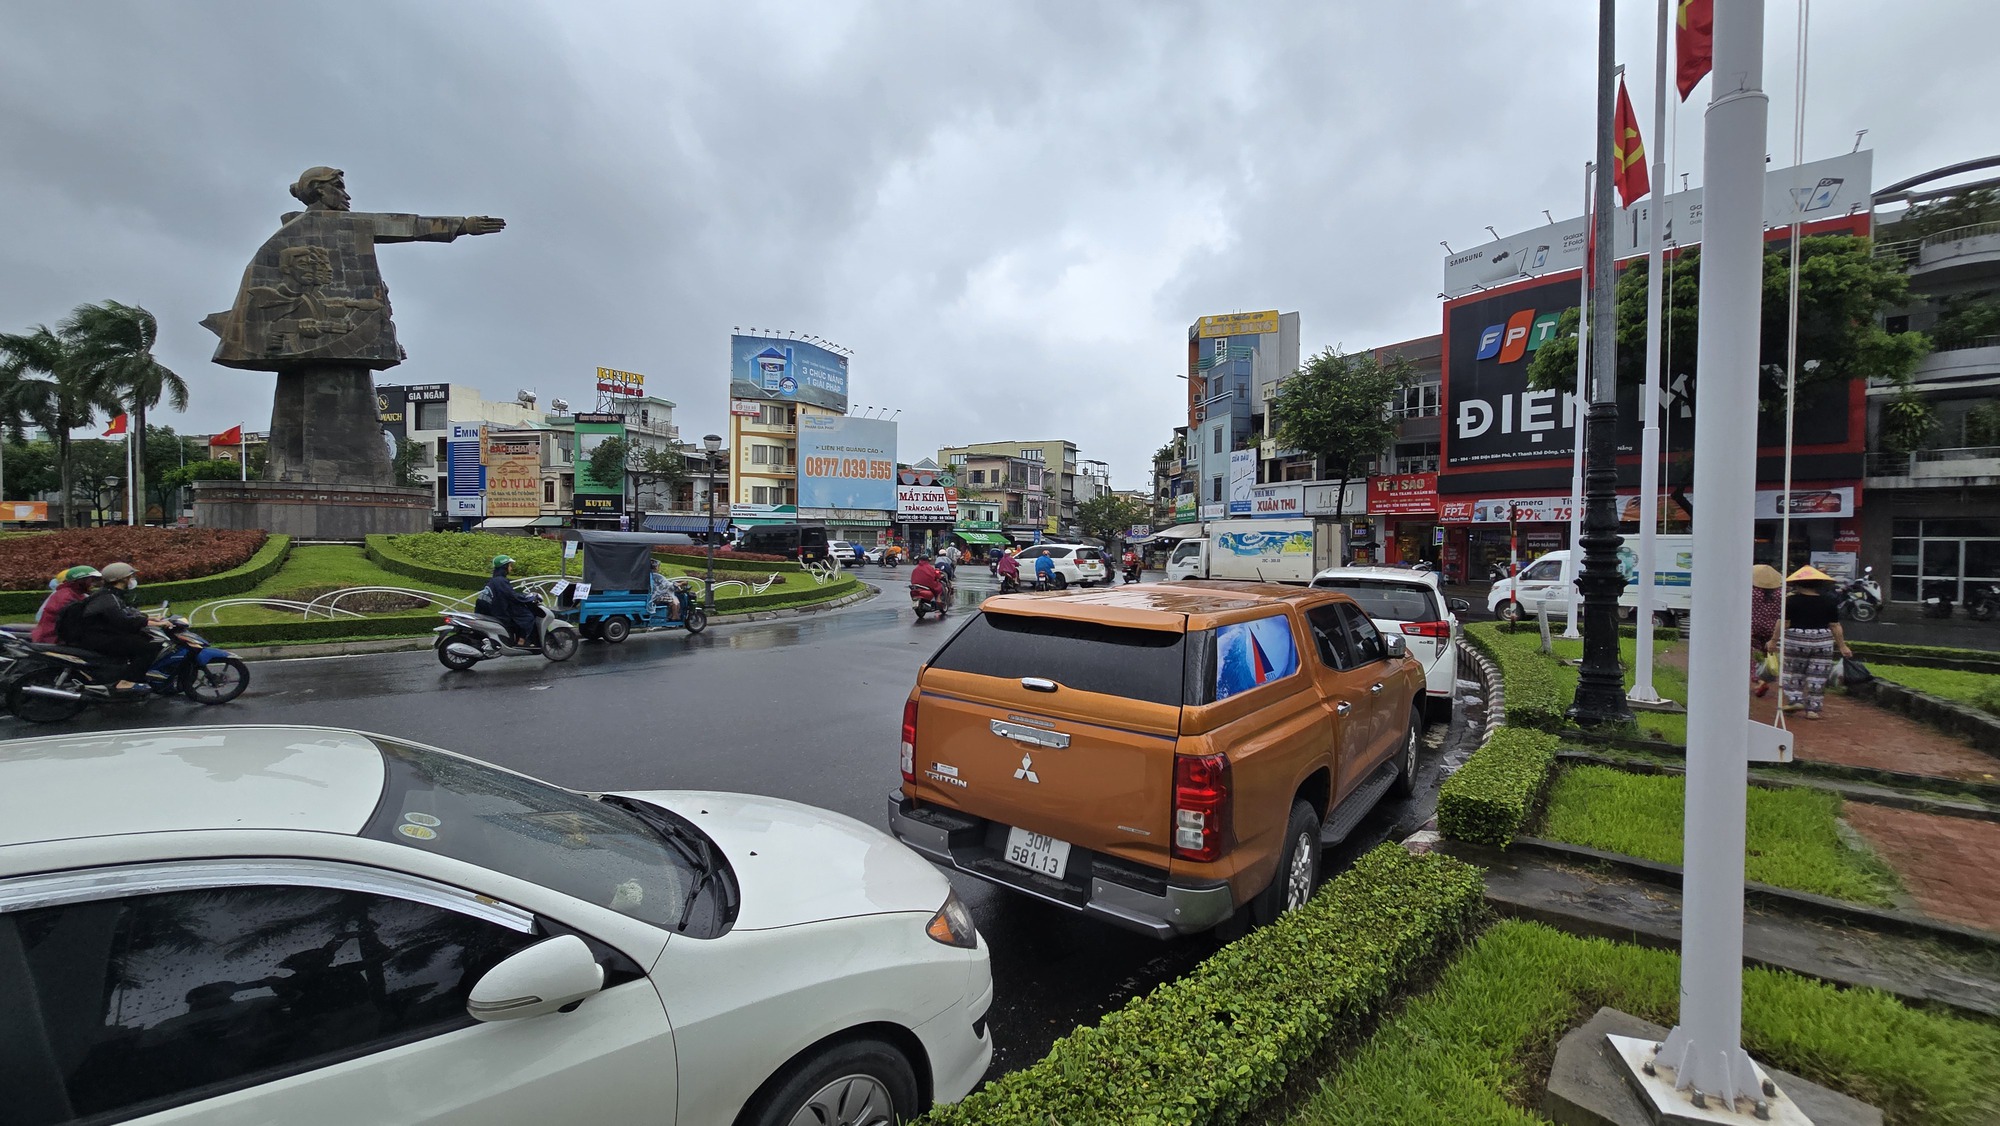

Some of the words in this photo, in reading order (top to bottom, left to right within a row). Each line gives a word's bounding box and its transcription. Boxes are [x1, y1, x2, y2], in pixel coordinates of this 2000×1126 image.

[1563, 231, 1585, 241] Galax
[1568, 238, 1585, 247] Fold
[1449, 252, 1483, 267] SAMSUNG
[1480, 320, 1555, 352] FPT
[802, 366, 808, 375] 3
[408, 391, 422, 401] GIA
[805, 456, 892, 481] 0877.039.555
[921, 490, 945, 502] KÍNH
[584, 499, 612, 507] KUTIN
[920, 504, 933, 512] CAO
[1257, 497, 1280, 512] XUÂN
[1280, 498, 1297, 511] THU
[1508, 499, 1544, 507] Camera
[1444, 507, 1464, 516] FPT
[924, 769, 968, 788] TRITON
[1025, 831, 1053, 854] 30M
[1011, 845, 1059, 874] 581.13
